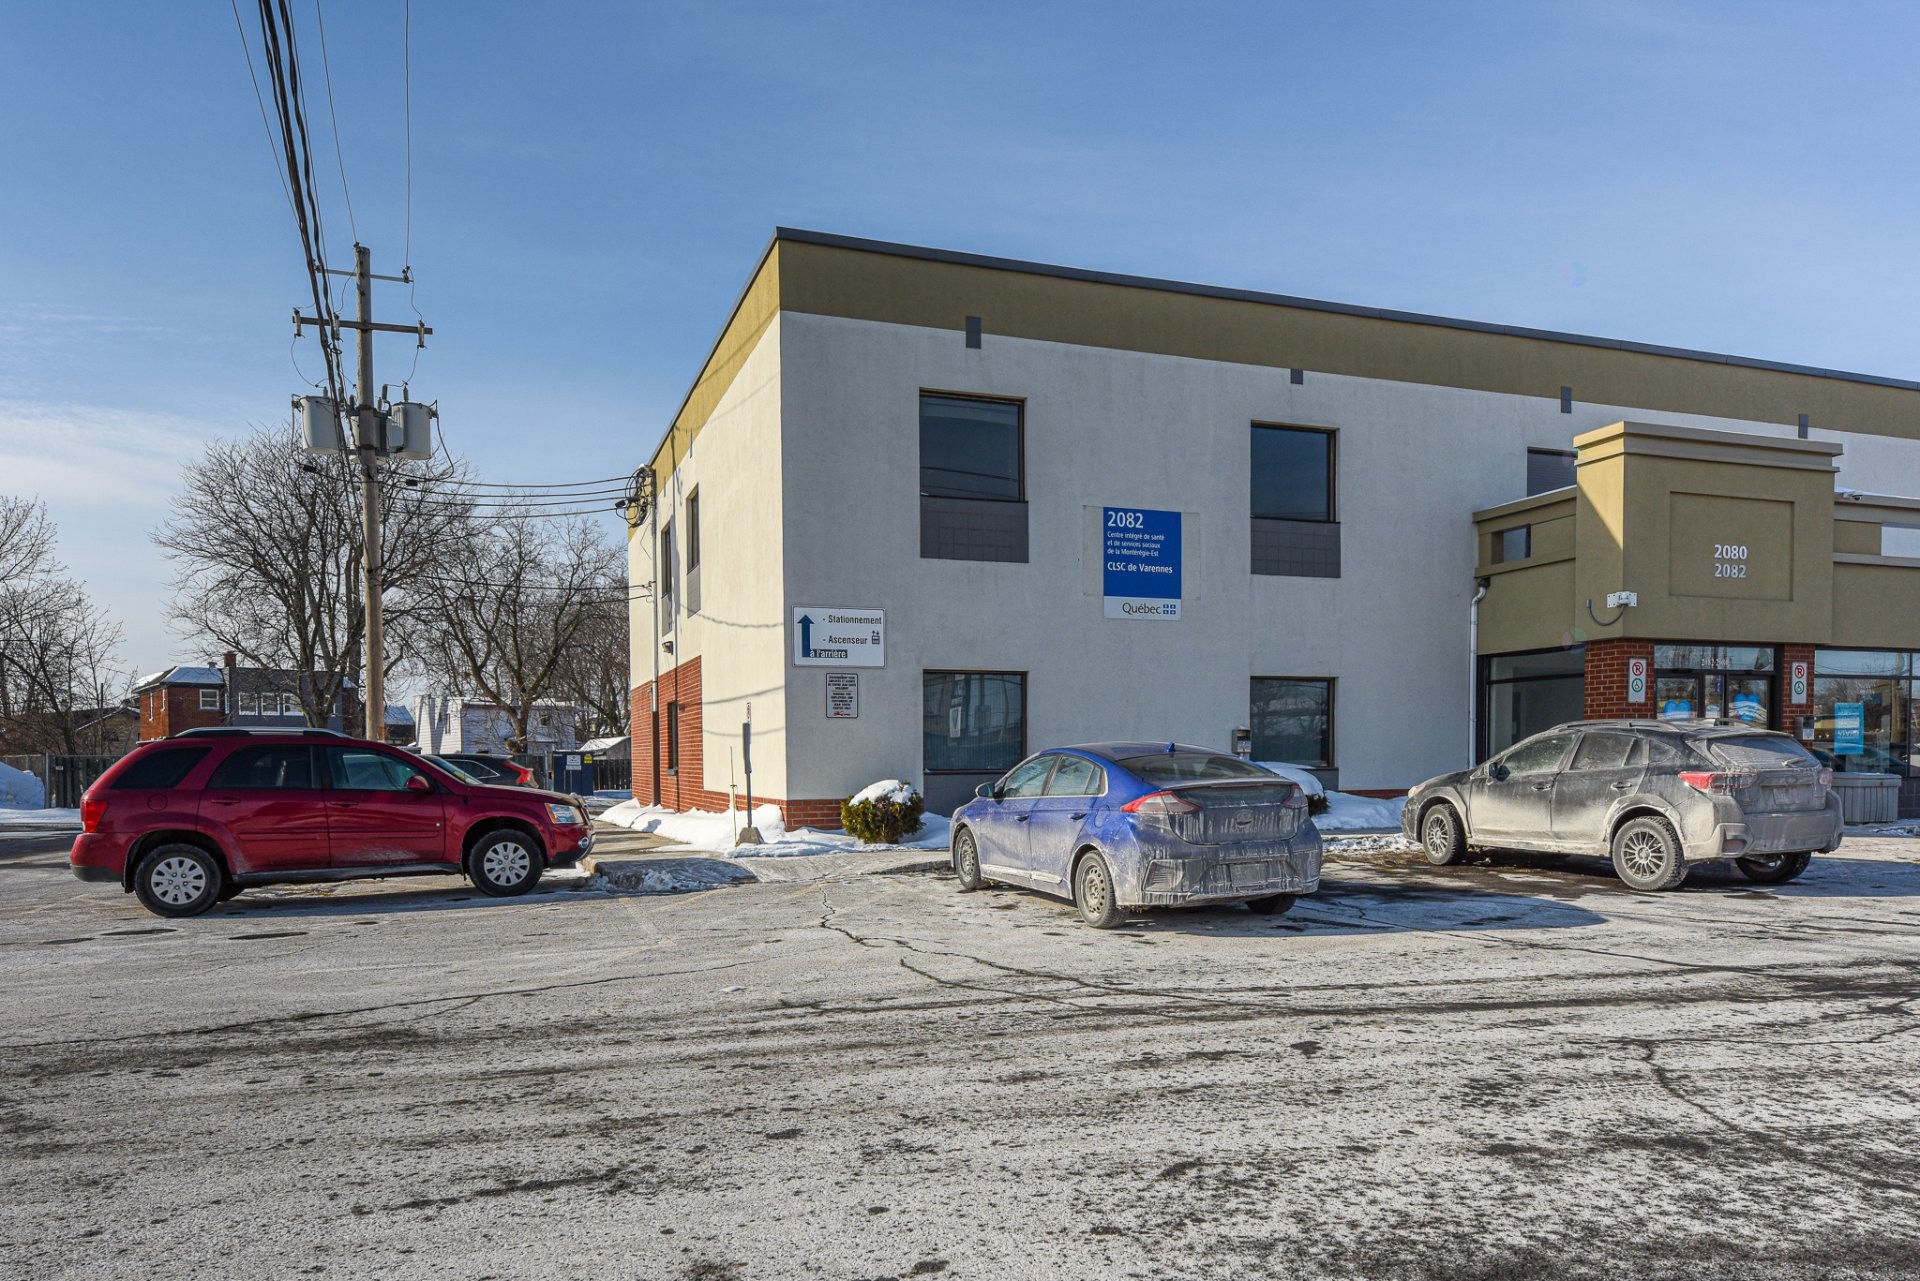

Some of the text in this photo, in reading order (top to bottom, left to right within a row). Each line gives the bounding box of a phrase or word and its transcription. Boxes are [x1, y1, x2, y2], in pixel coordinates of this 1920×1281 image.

[1107, 511, 1144, 529] 2082
[1107, 531, 1124, 539] Centre
[1143, 532, 1150, 540] de
[1714, 543, 1748, 560] 2080
[1107, 561, 1173, 574] CLSC de Varennes
[1714, 563, 1747, 578] 2082
[1122, 602, 1162, 615] Québec
[828, 614, 882, 625] Stationnement
[828, 635, 868, 645] Ascenseur
